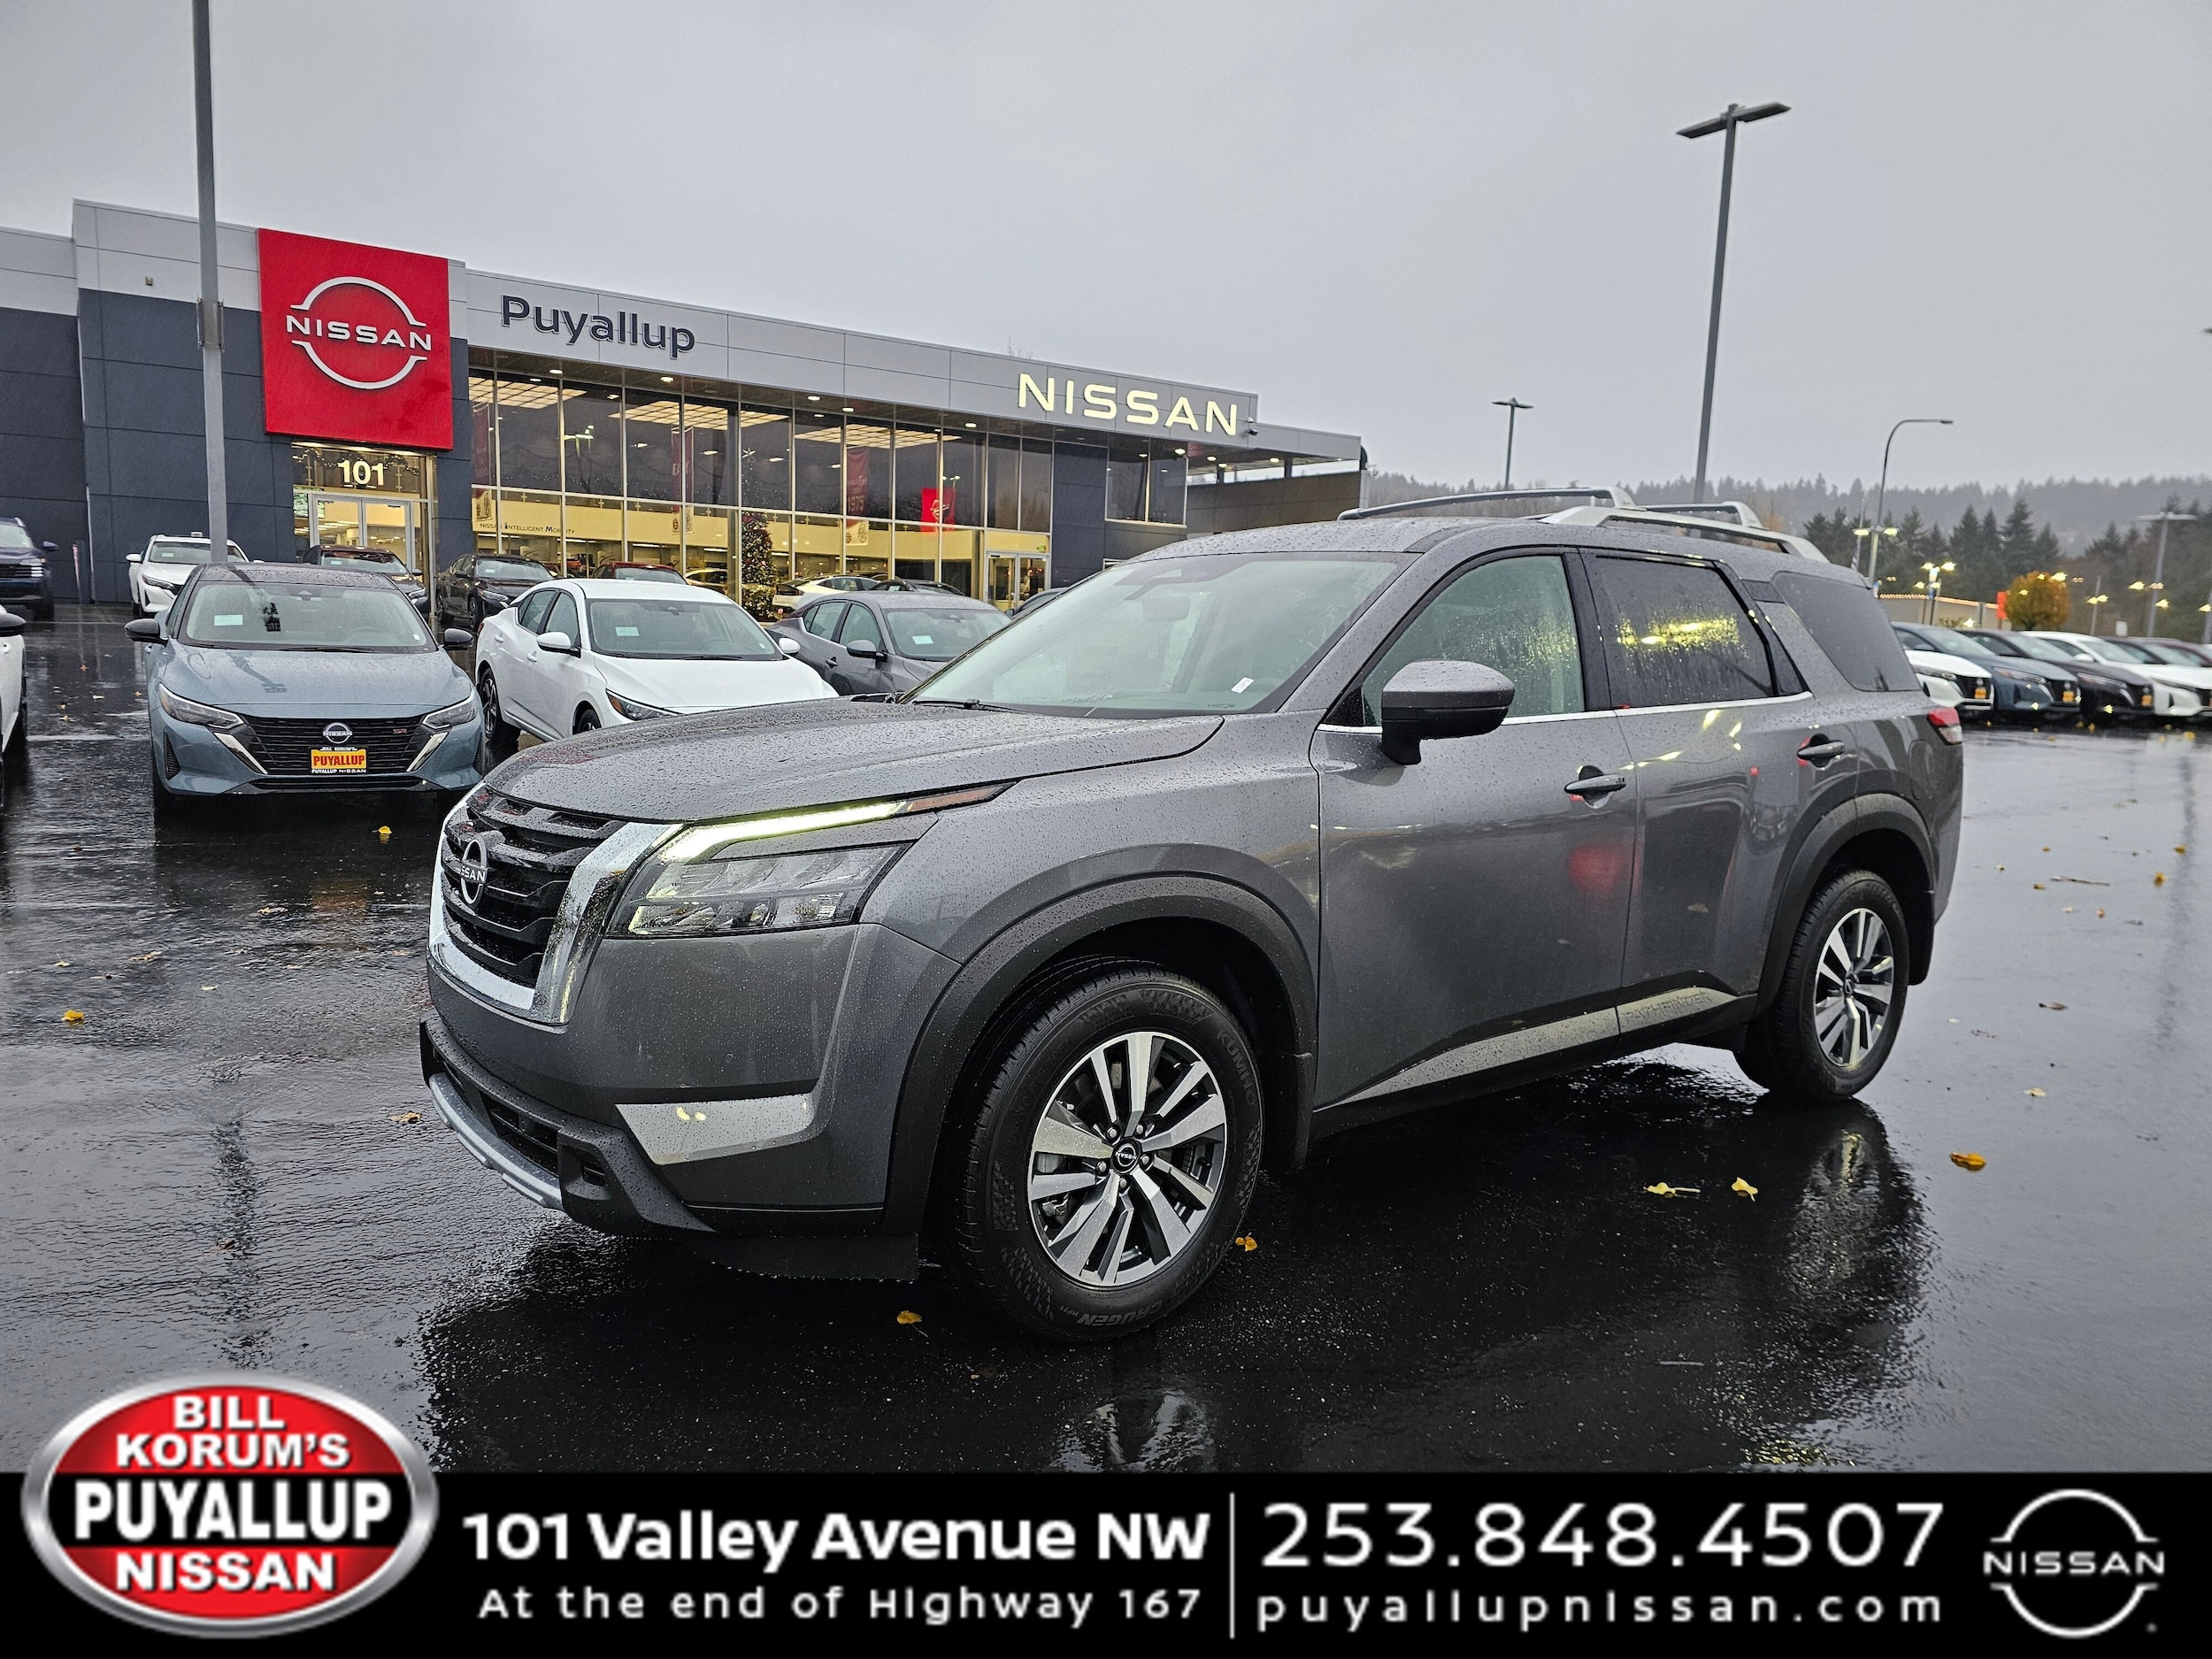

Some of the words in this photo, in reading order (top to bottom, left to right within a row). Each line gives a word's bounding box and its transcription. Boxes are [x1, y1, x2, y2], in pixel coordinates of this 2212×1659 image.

[286, 314, 432, 351] NISSAN
[501, 294, 695, 359] Puyallup
[1018, 373, 1237, 435] NISSAN
[337, 459, 384, 486] 101
[313, 756, 365, 766] PUYALLUP
